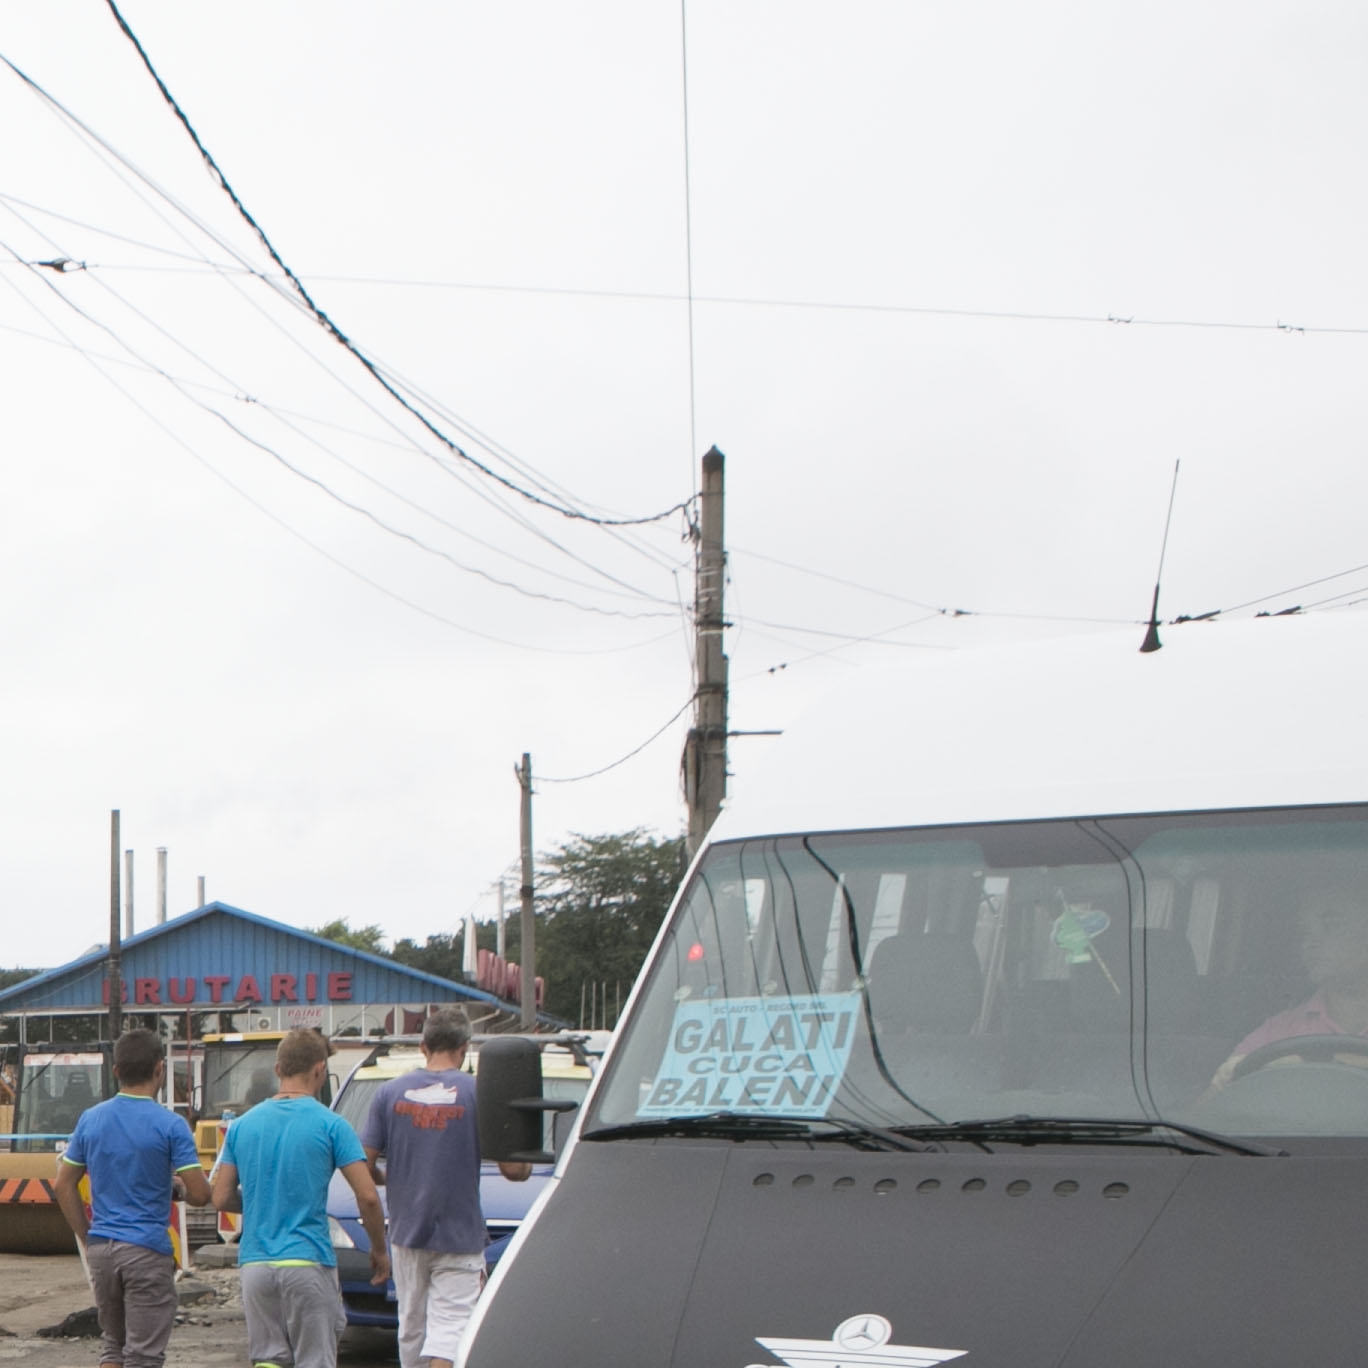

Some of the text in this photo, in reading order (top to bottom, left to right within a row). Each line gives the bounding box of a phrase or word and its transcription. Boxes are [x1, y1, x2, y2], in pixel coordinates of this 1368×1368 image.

[674, 1011, 852, 1054] GALATI
[688, 1054, 814, 1075] CUCA
[647, 1075, 835, 1107] BALENI
